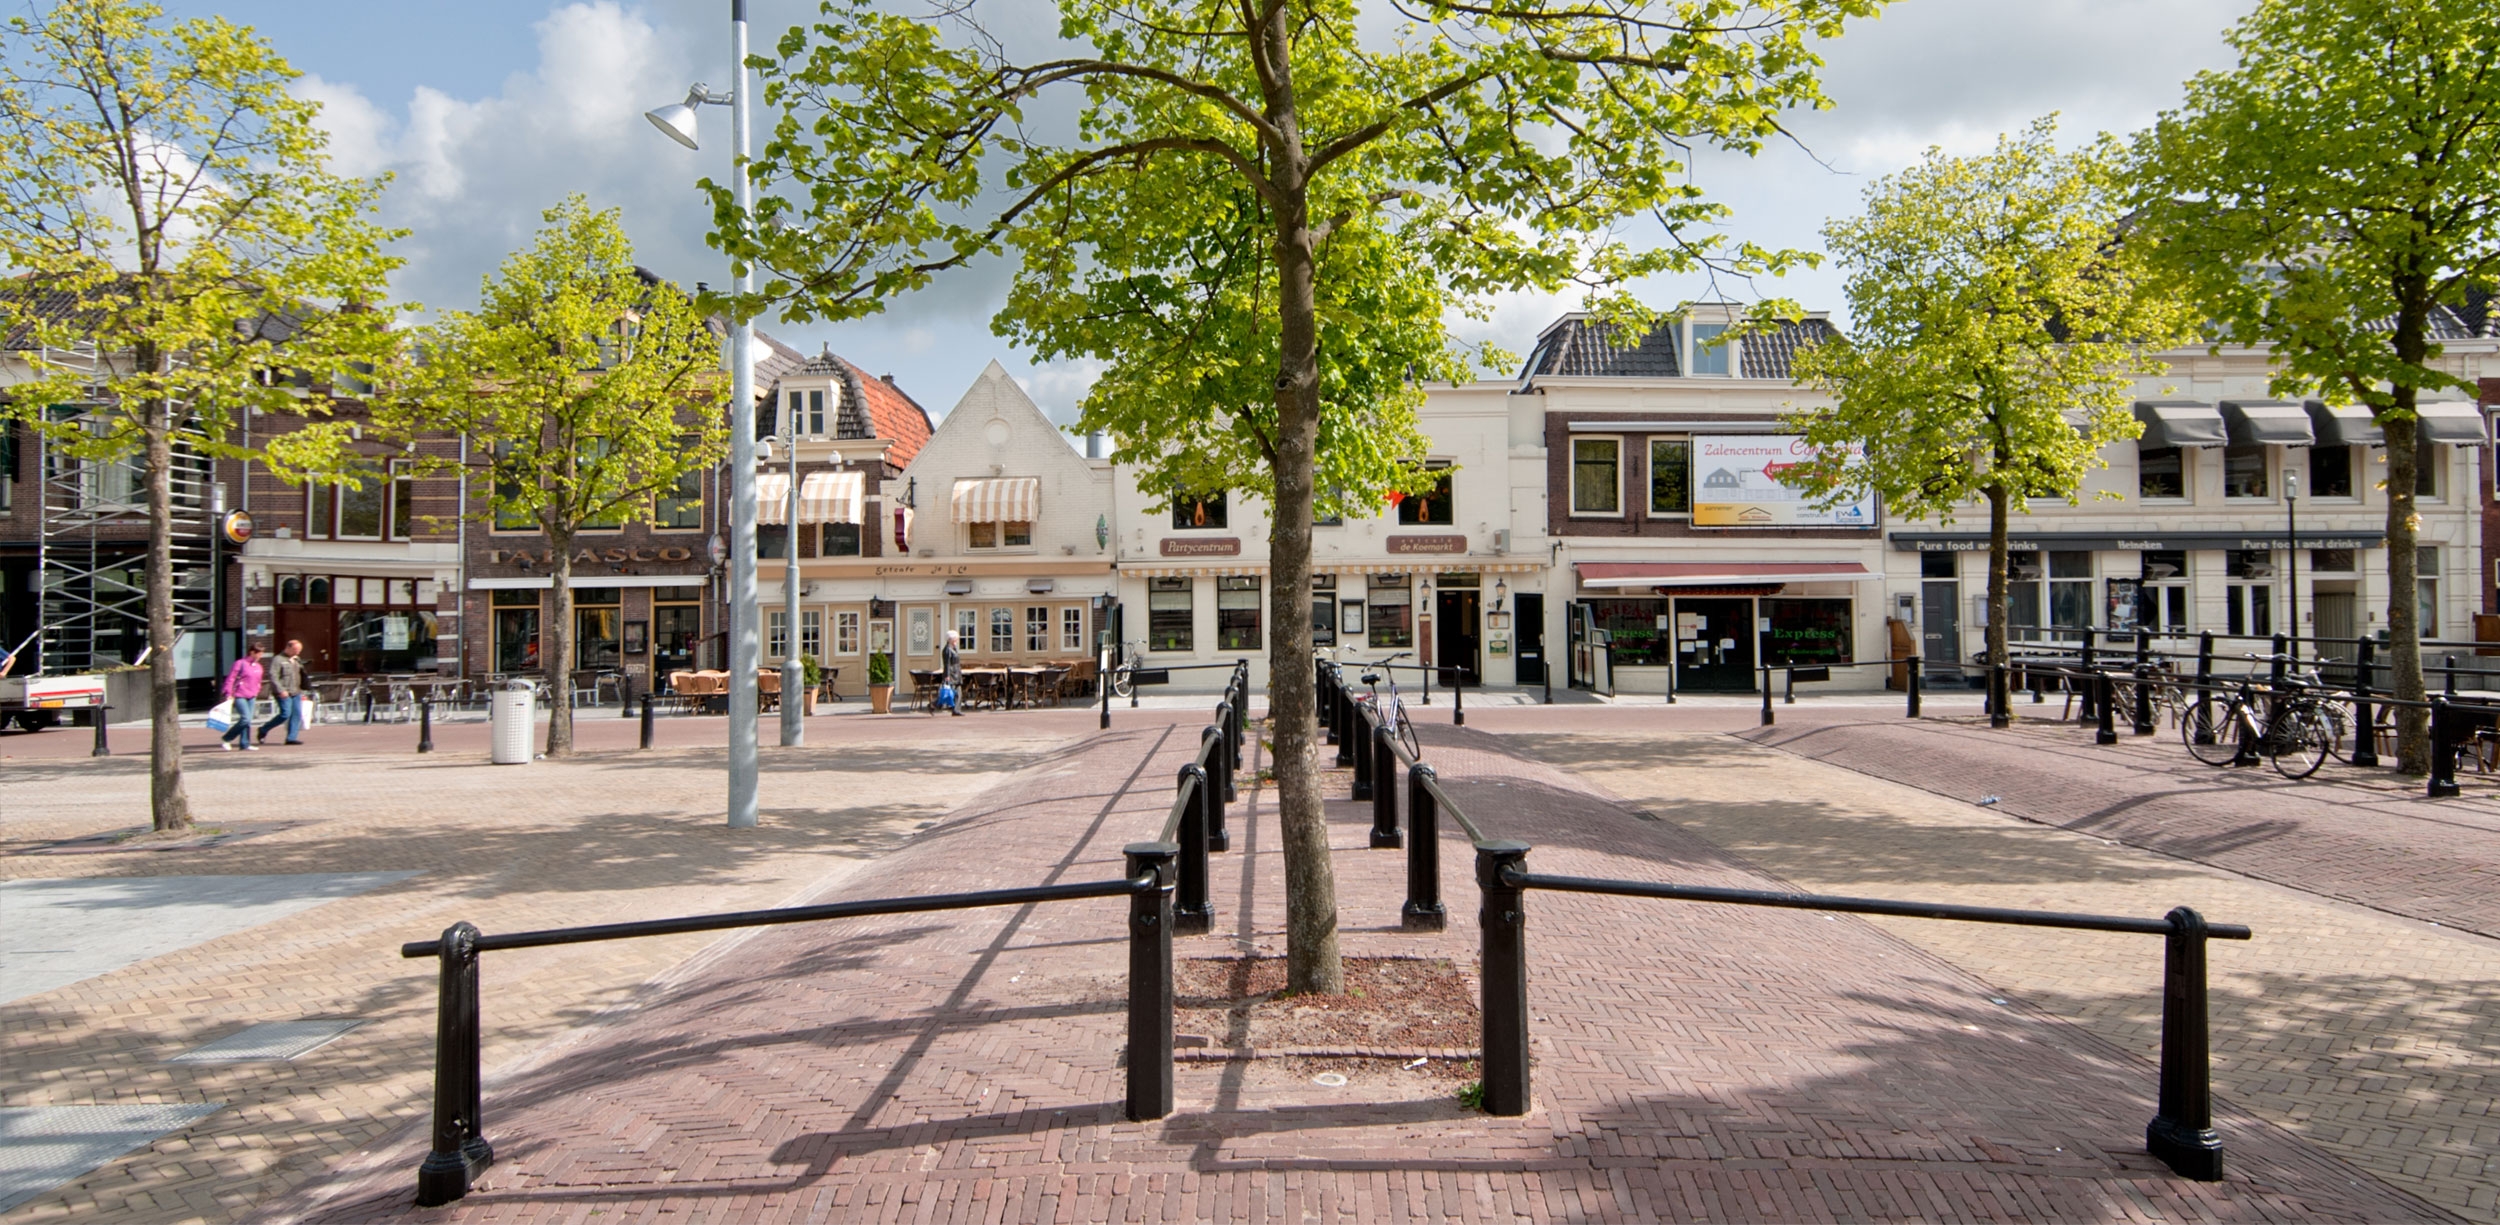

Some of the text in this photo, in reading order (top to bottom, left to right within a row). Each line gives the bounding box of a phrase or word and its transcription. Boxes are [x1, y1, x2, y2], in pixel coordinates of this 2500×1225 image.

[1704, 439, 1863, 456] Zalencentrum Conia
[1168, 540, 1234, 554] Partycentrum
[1400, 543, 1454, 551] de Koemarkt
[1917, 541, 2039, 550] Pure food an rinks
[2117, 540, 2163, 550] Heineken
[2242, 540, 2269, 549] Pure
[2302, 539, 2324, 549] and
[2326, 539, 2362, 549] drinks
[1613, 630, 1655, 641] press
[1773, 628, 1837, 641] Express
